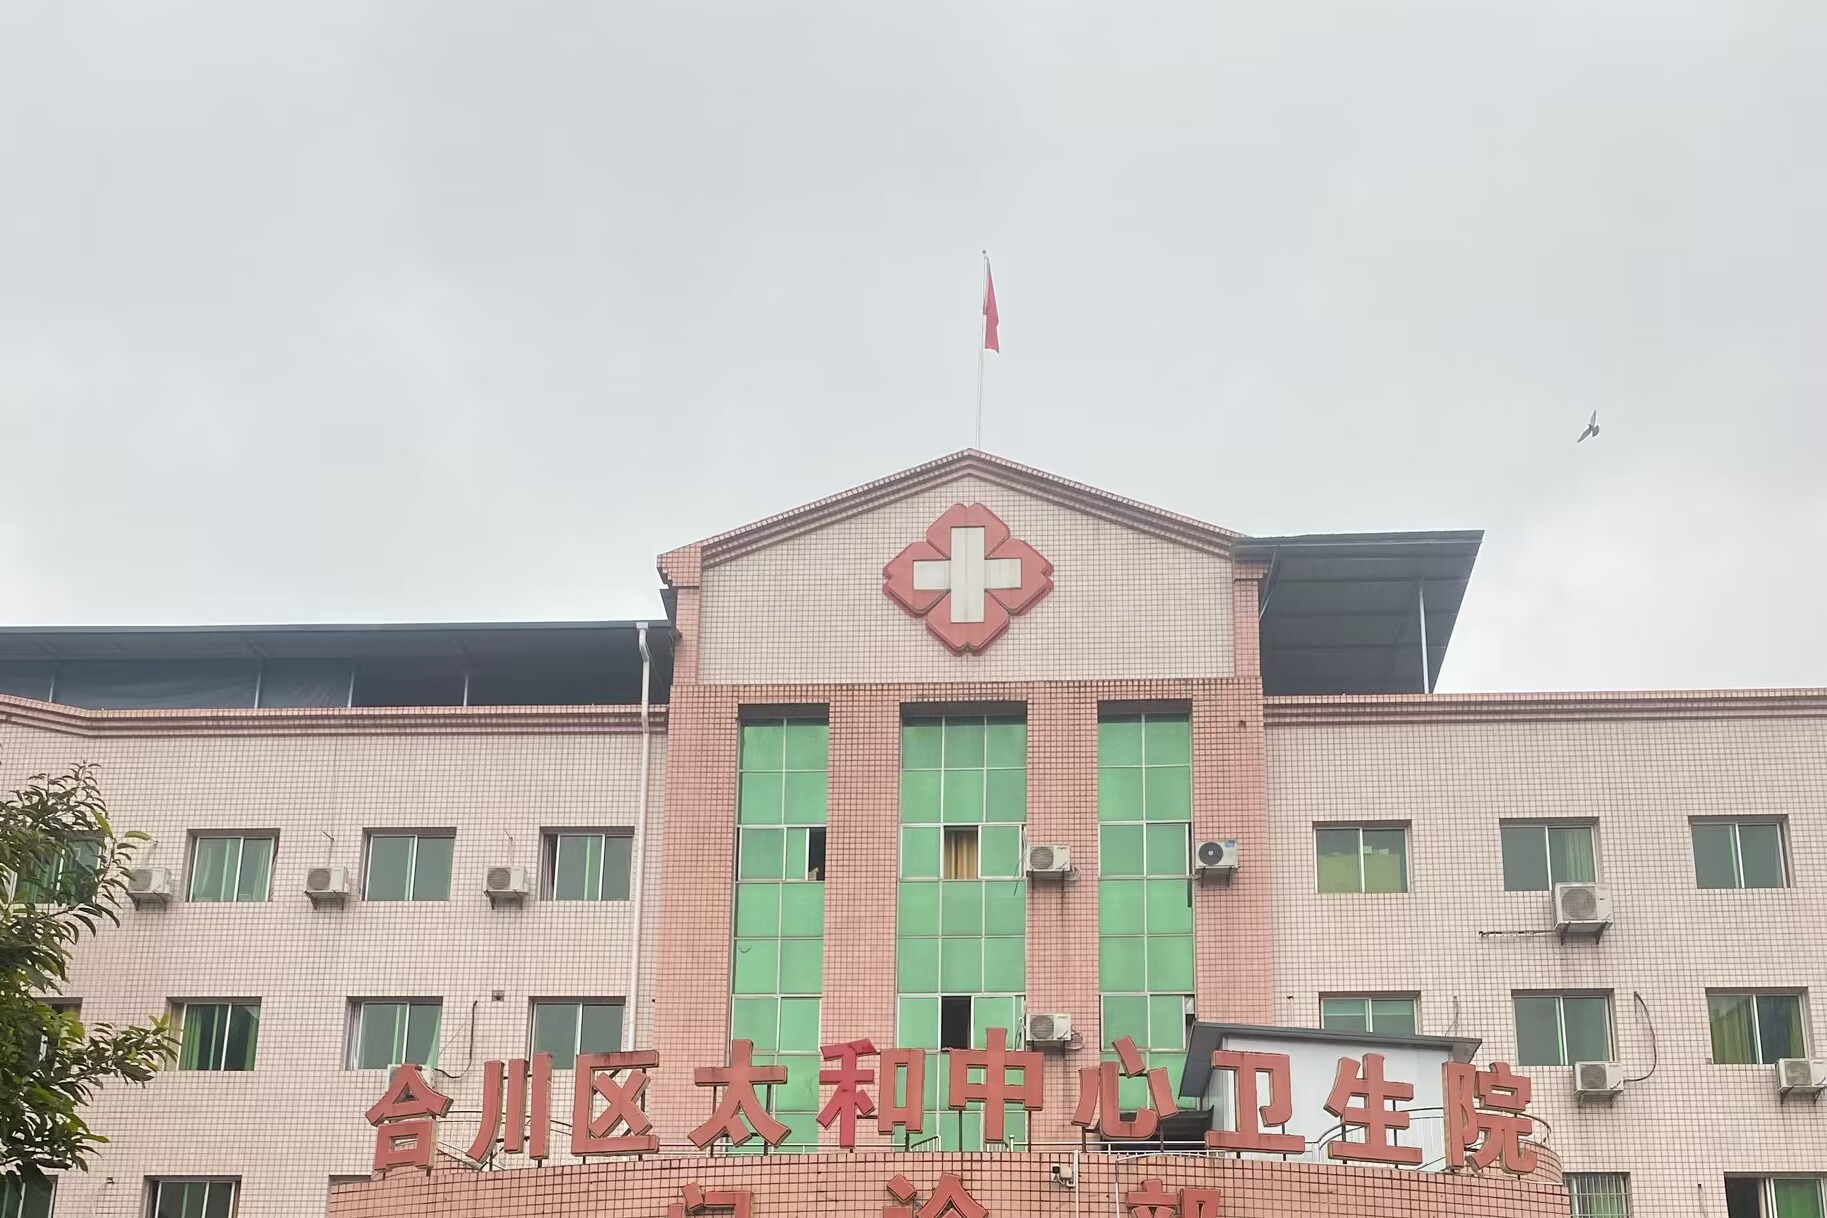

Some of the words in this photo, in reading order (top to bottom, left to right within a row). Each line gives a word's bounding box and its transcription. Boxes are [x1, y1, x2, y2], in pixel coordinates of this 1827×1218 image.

[366, 1028, 1535, 1174] 合川区太和中心卫生院
